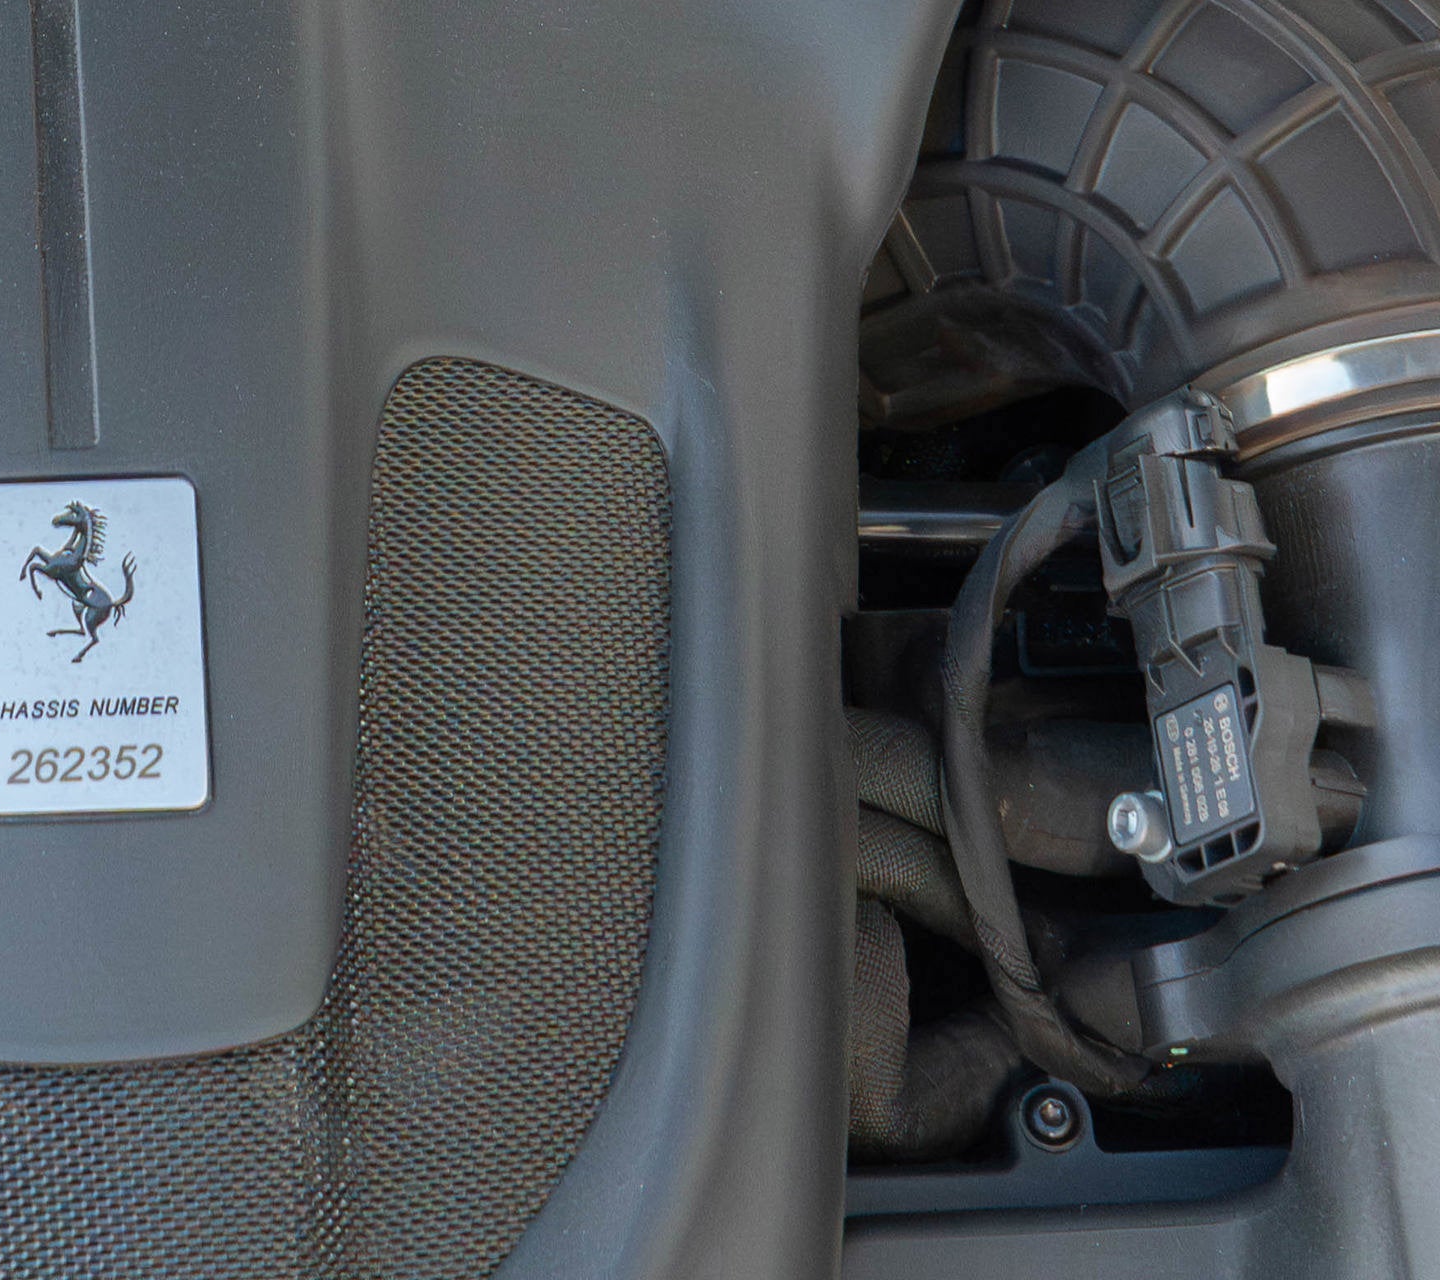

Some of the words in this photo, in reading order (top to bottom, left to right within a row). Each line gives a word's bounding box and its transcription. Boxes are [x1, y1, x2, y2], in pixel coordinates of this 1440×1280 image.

[90, 696, 179, 717] NUMBER
[7, 743, 164, 785] 262352
[1219, 716, 1241, 782] BOSCH
